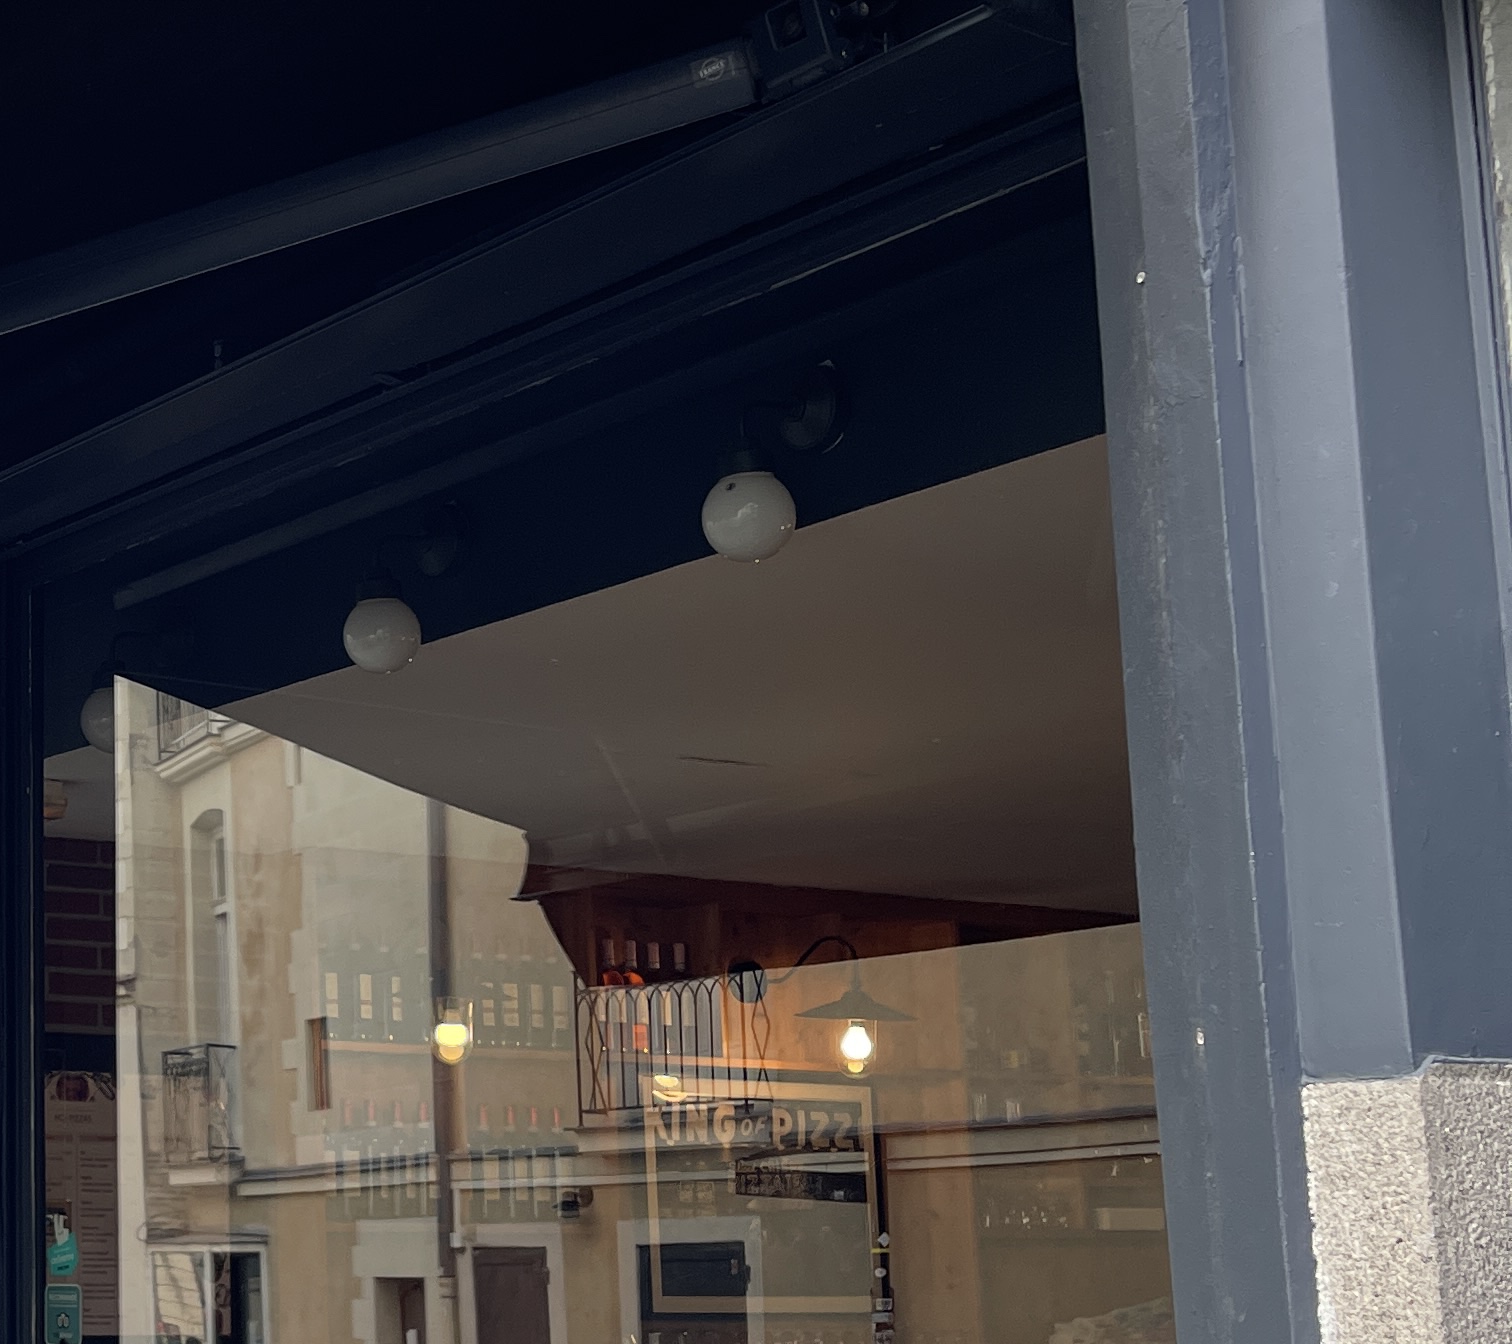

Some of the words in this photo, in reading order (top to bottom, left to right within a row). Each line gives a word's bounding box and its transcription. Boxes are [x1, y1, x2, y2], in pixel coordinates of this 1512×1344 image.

[645, 1102, 736, 1146] KING
[741, 1116, 768, 1137] OF
[771, 1106, 865, 1152] PIZZ
